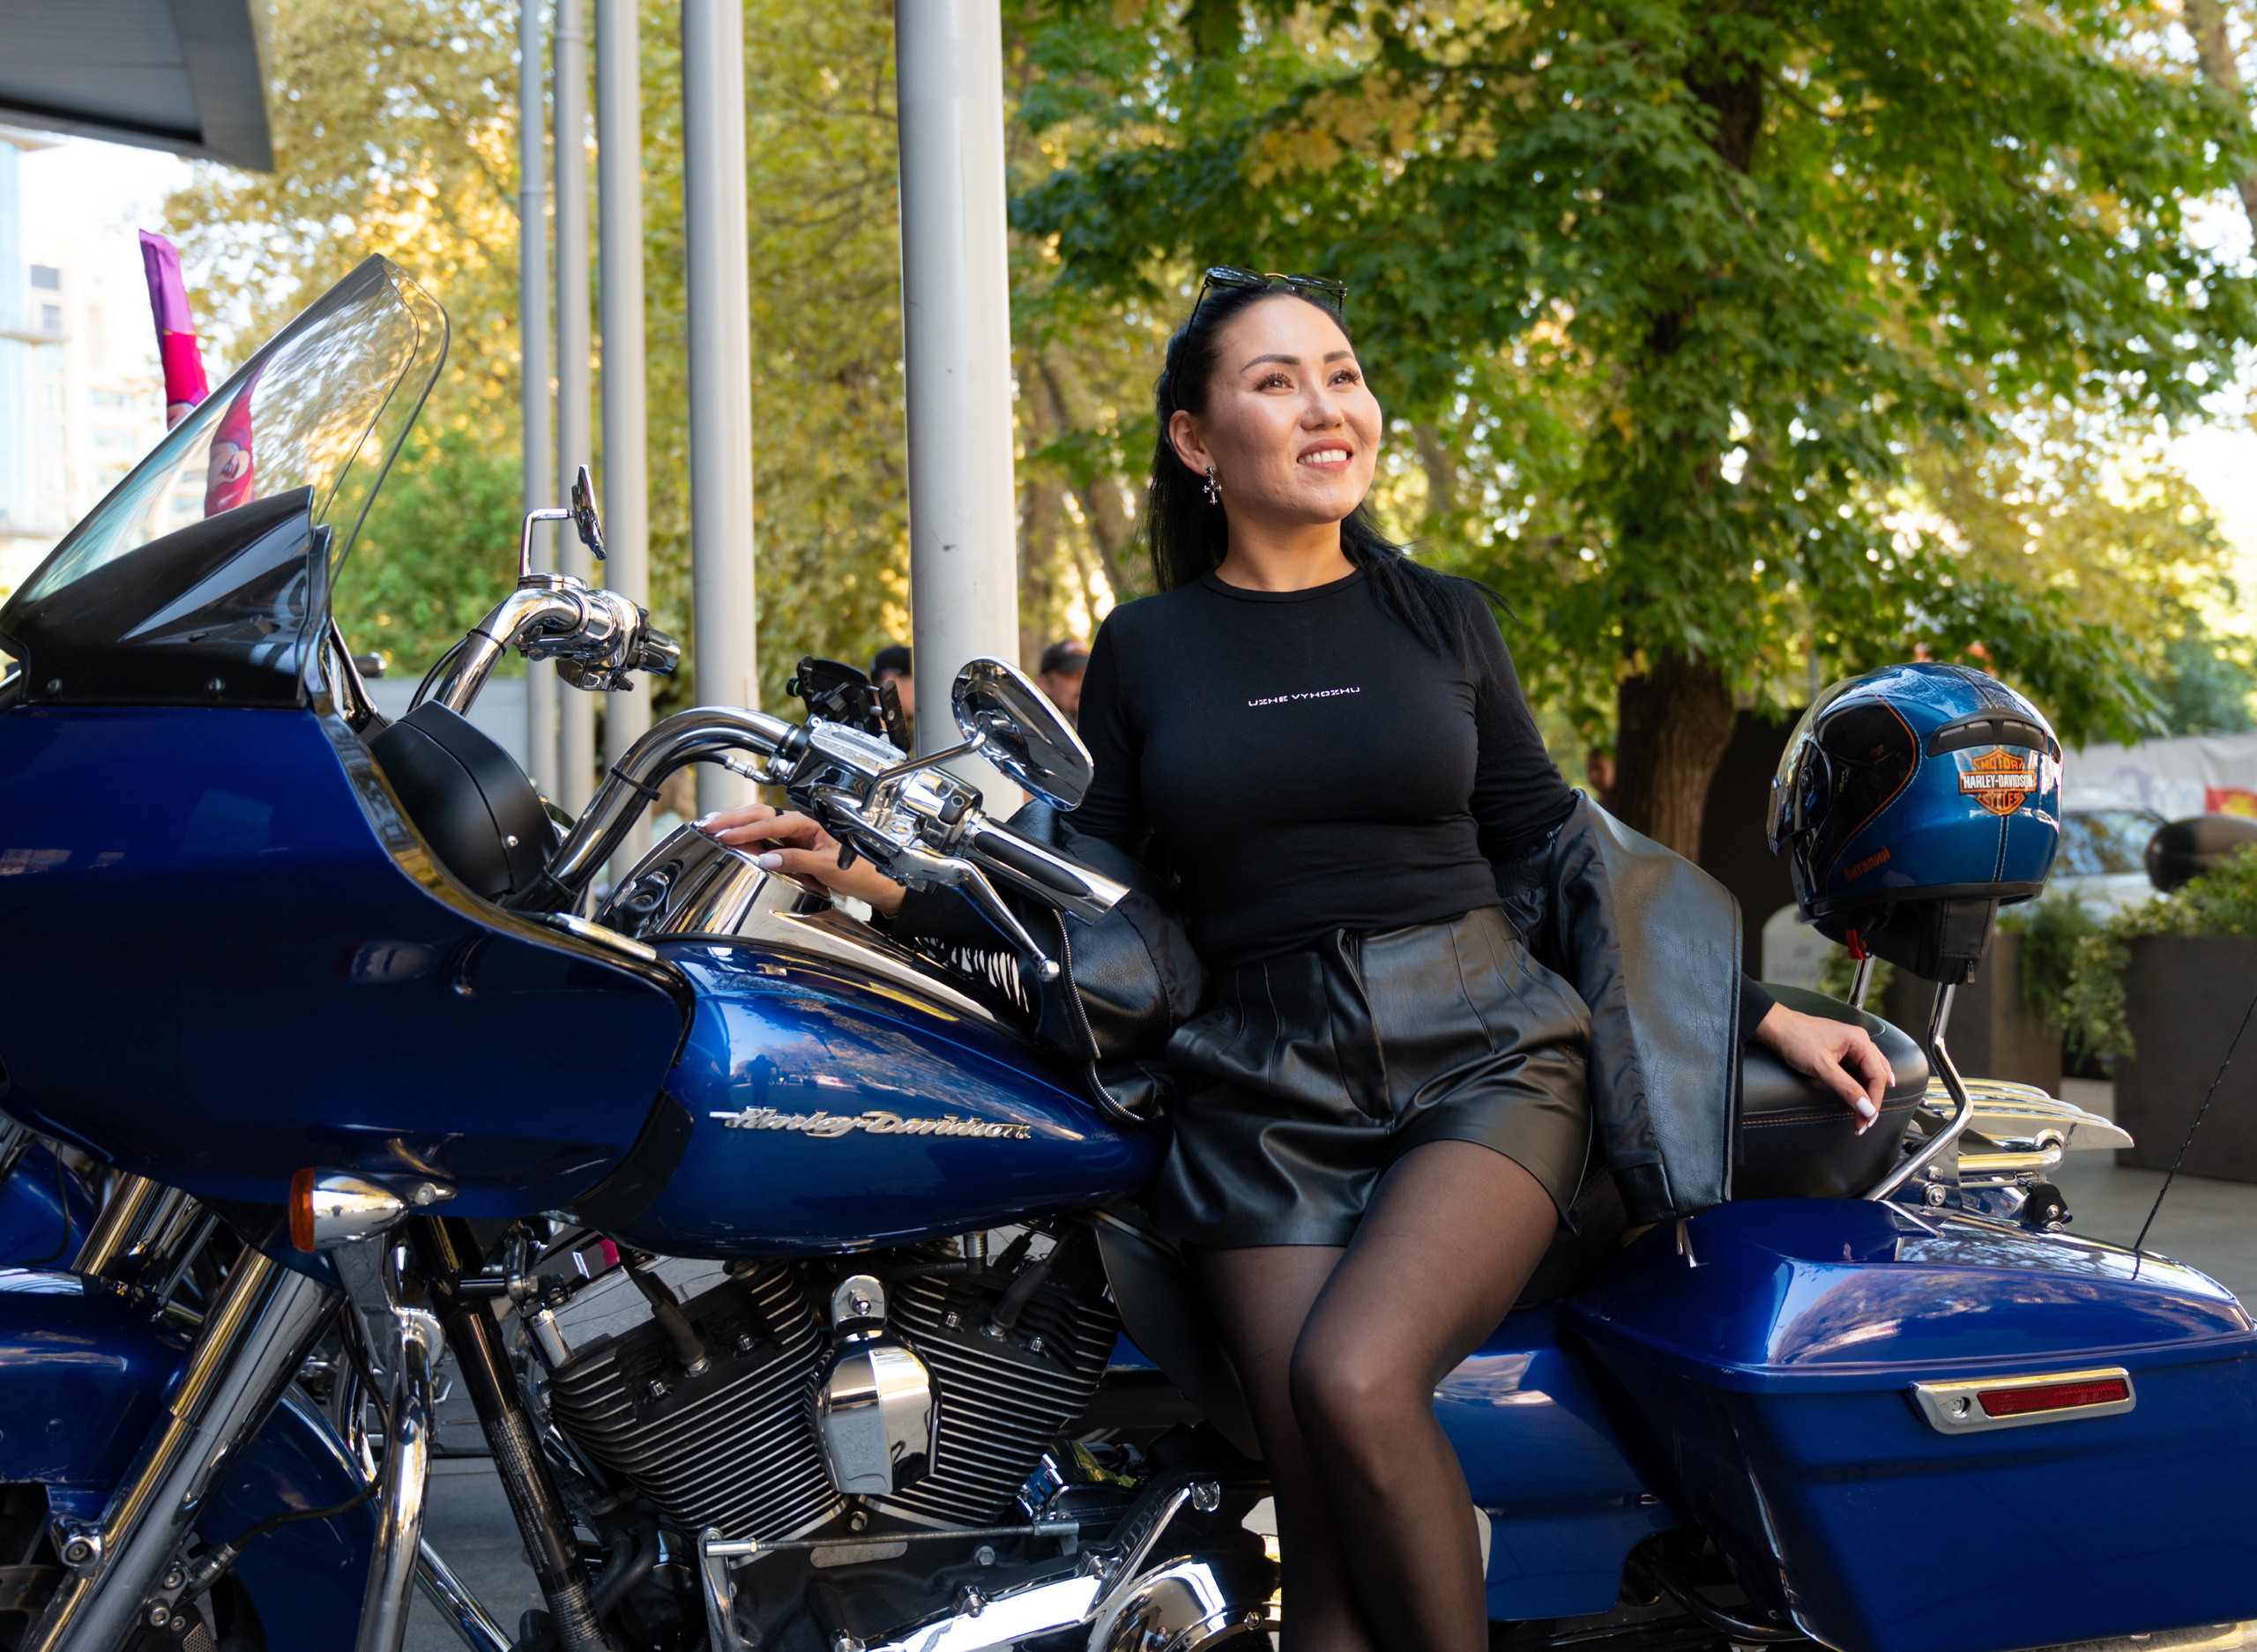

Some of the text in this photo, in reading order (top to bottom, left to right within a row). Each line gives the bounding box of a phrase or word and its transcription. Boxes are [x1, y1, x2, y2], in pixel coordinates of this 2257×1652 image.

[1248, 696, 1288, 706] UZHE
[1980, 754, 2018, 770] MOTOR
[1963, 774, 2032, 789] HARLEY-DAVIDSON
[1982, 793, 2020, 811] CYCLES
[709, 1105, 1031, 1139] Harley-Davidson
